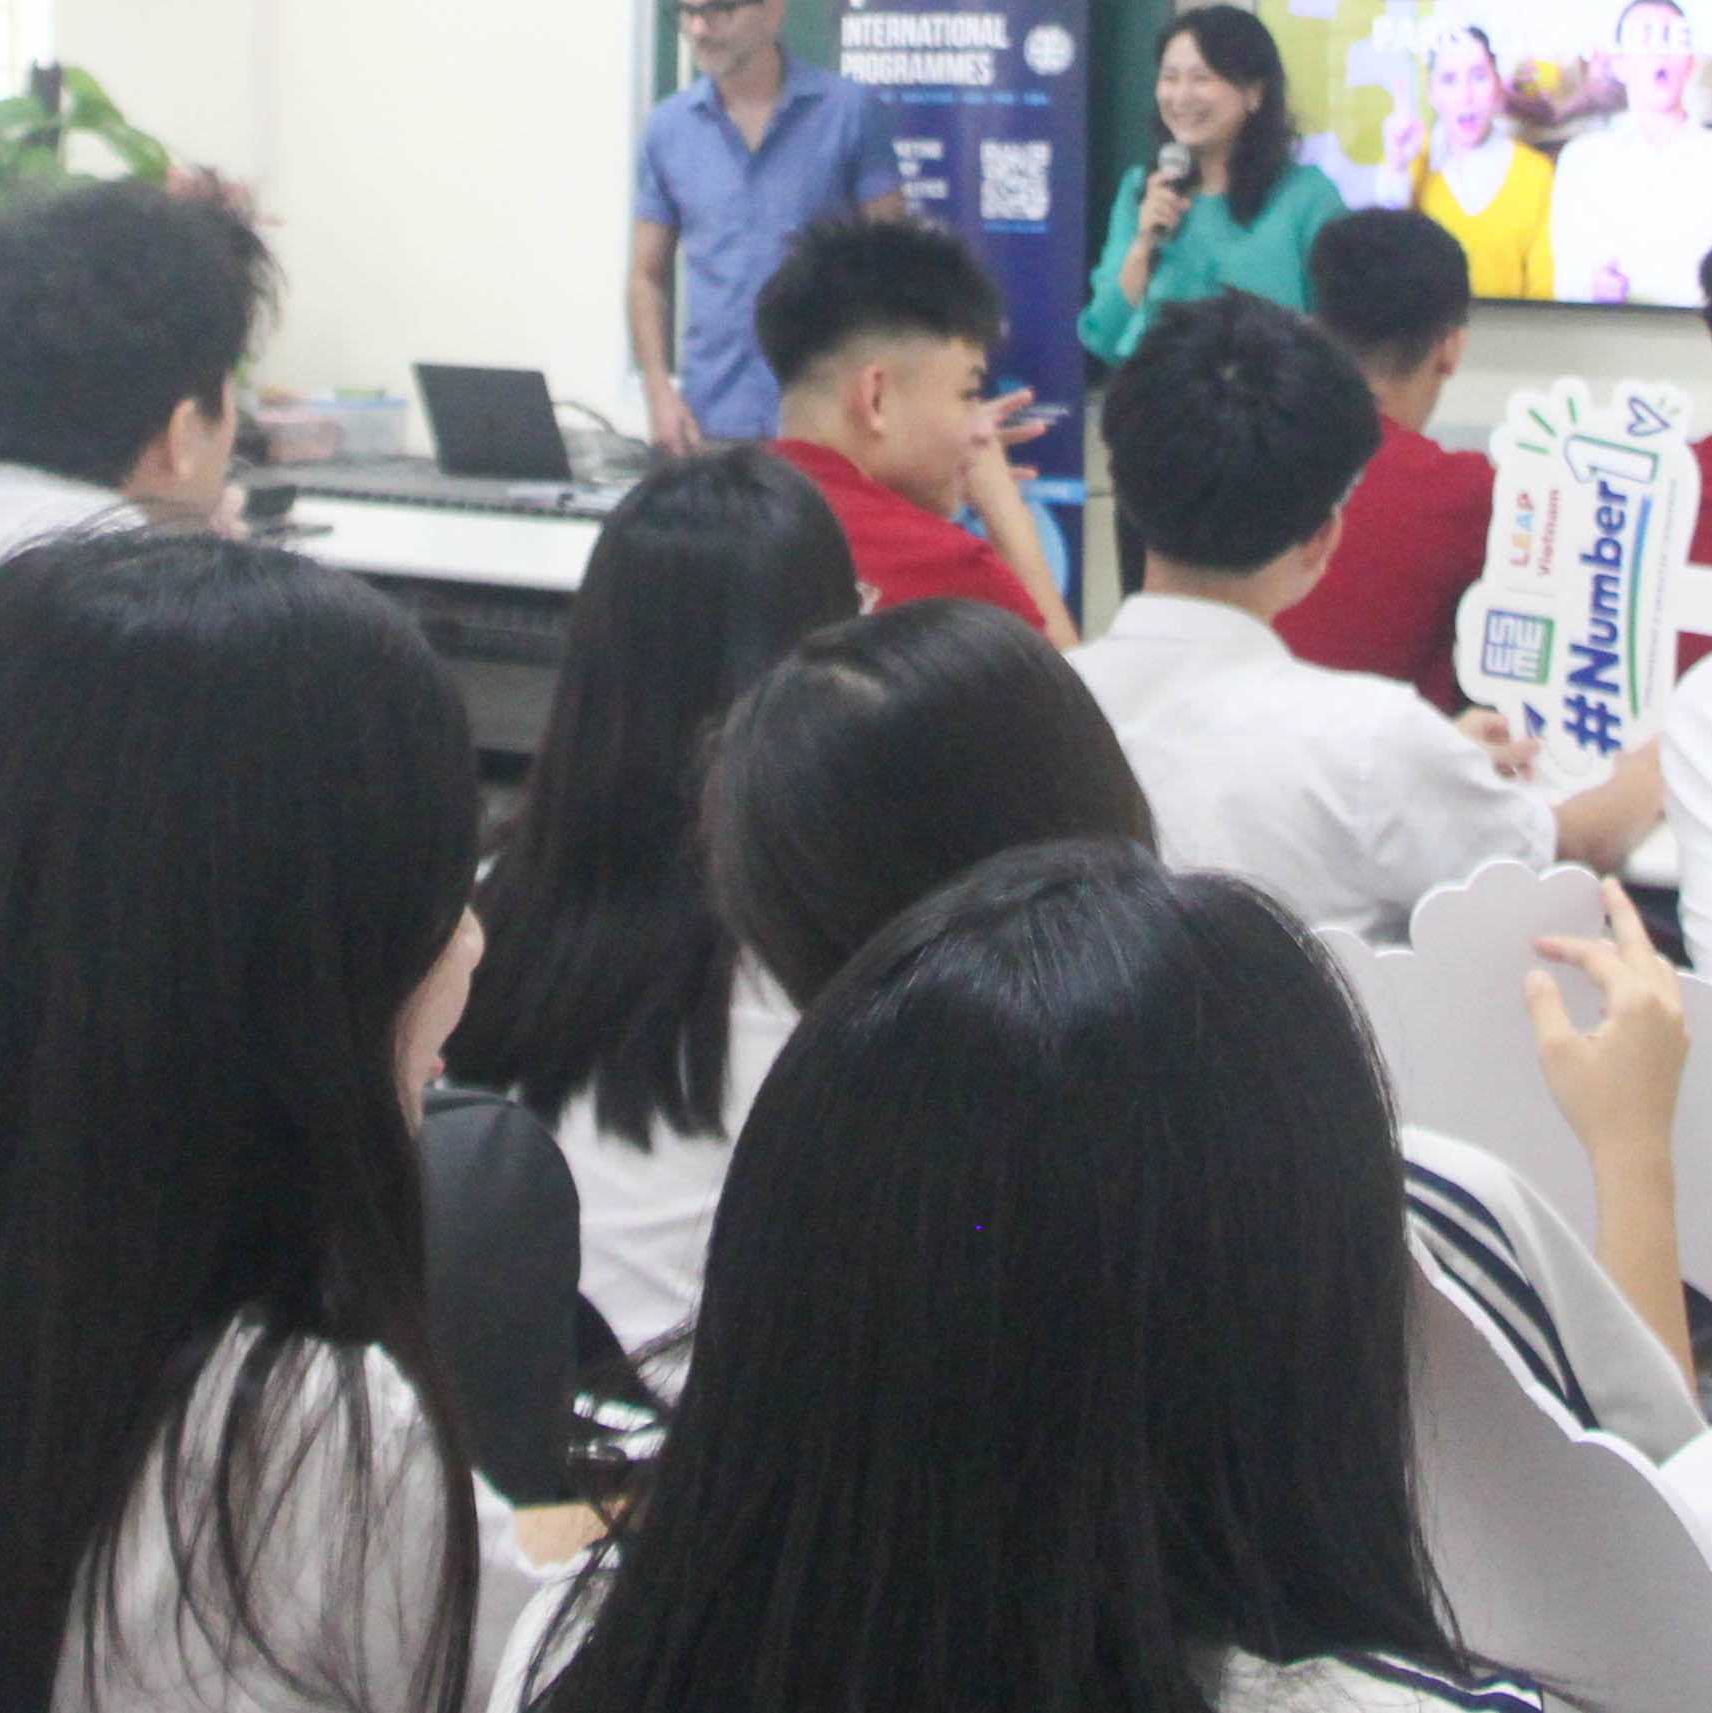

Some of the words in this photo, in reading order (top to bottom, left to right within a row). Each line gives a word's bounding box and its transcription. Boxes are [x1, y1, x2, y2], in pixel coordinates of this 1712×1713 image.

[841, 12, 1010, 49] INTERNATIONAL
[840, 50, 995, 86] PROGRAMMES
[1509, 492, 1536, 568] LEAP
[1536, 488, 1561, 577] Vietnam
